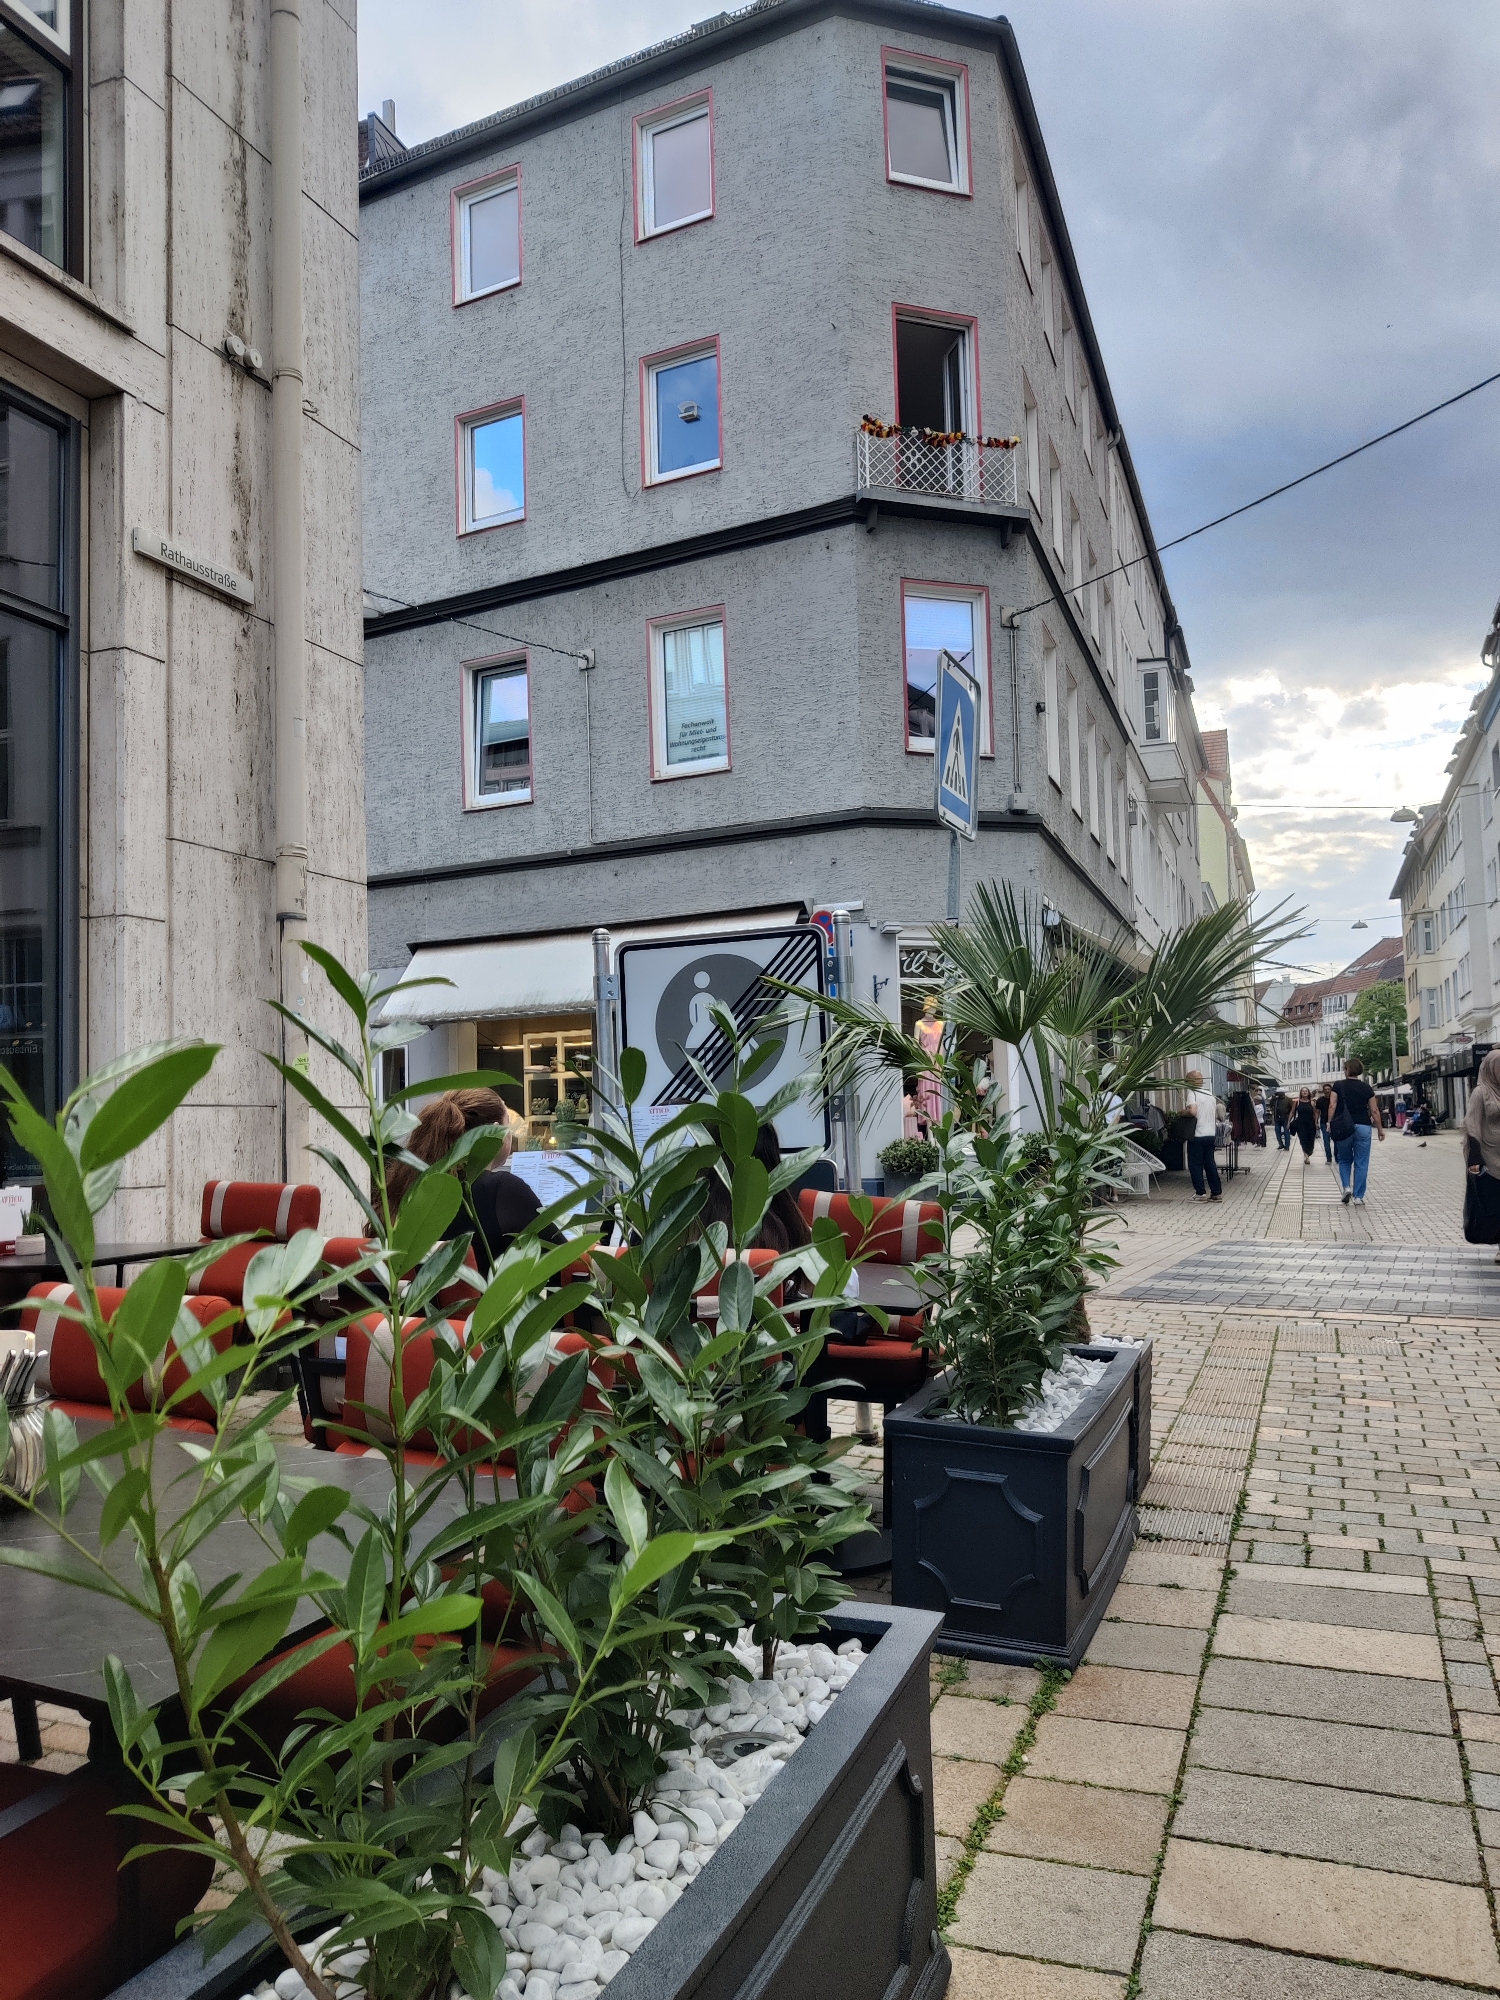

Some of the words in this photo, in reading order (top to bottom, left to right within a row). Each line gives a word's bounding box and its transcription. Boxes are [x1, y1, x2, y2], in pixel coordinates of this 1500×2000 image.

[160, 542, 237, 591] Rathausstraße
[681, 718, 715, 729] Fachanwalt
[679, 730, 688, 739] für
[705, 726, 717, 734] und
[690, 745, 707, 753] recht
